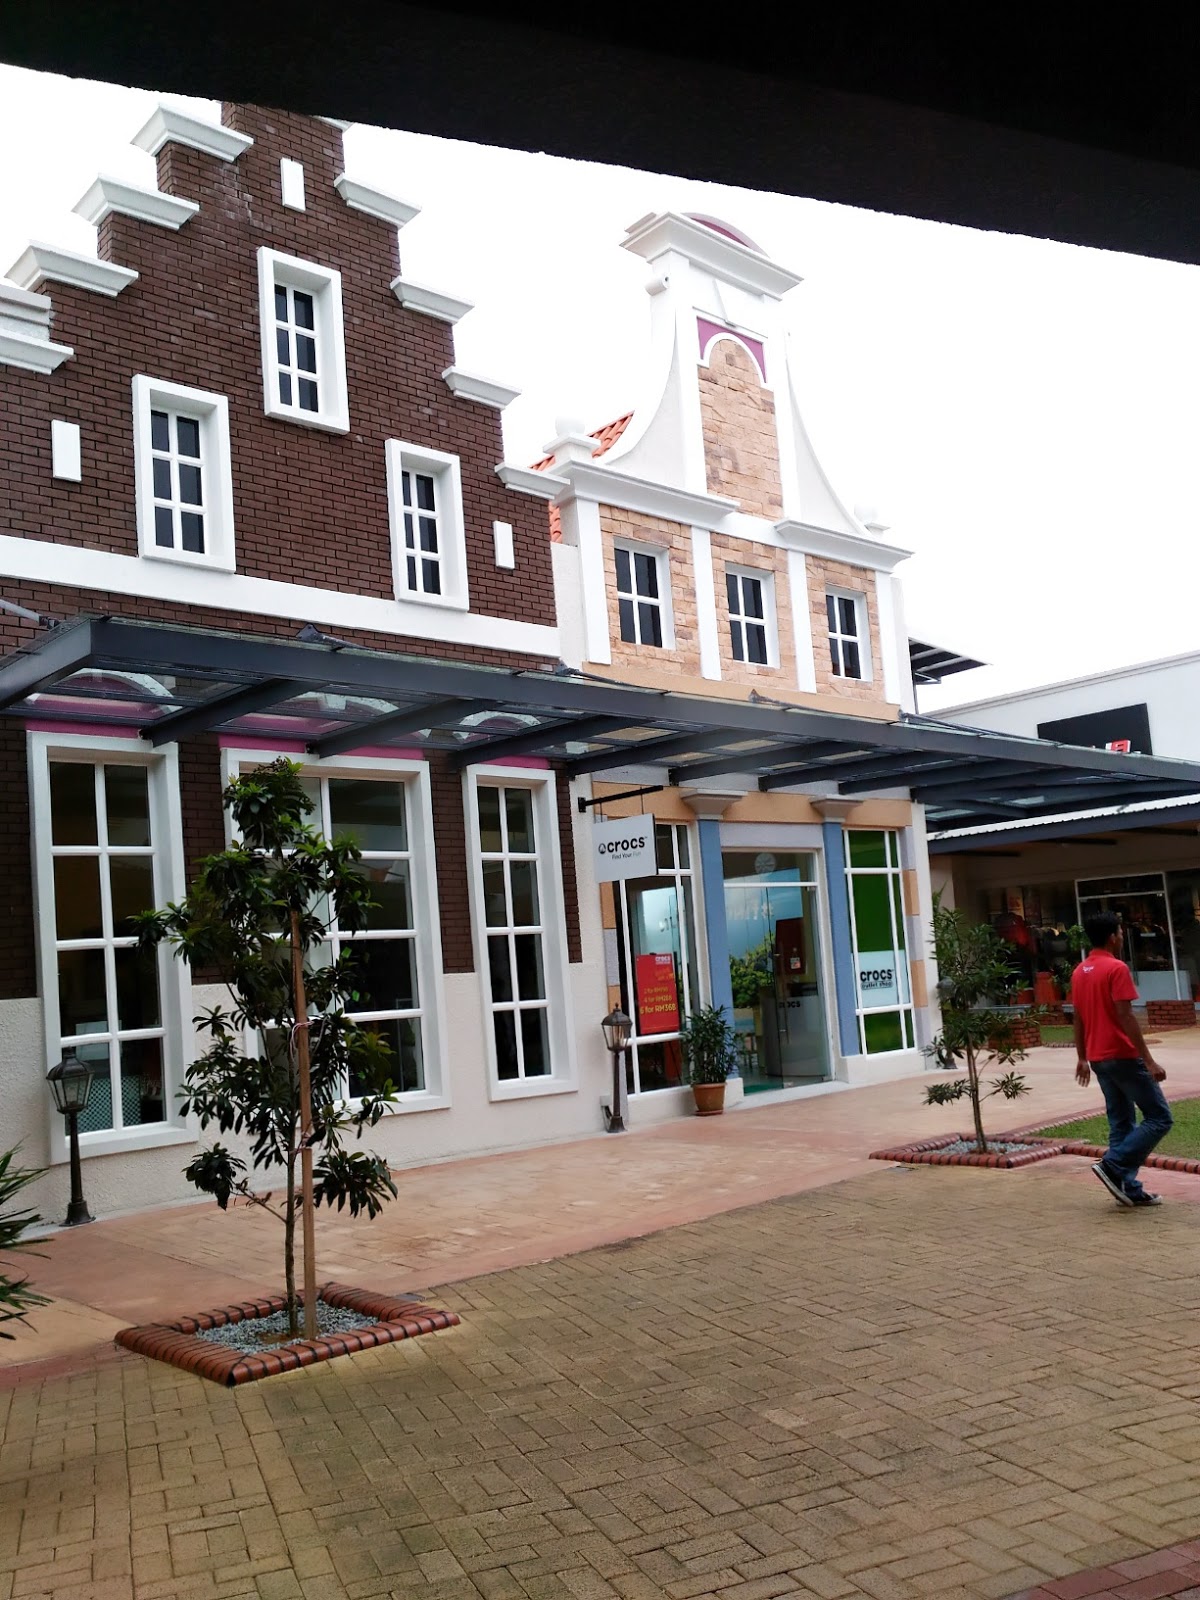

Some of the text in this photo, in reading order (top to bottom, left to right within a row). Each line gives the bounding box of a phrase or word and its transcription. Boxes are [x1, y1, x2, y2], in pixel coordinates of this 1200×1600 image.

[607, 836, 645, 853] crocs
[860, 969, 893, 982] crocs
[645, 1005, 655, 1014] for
